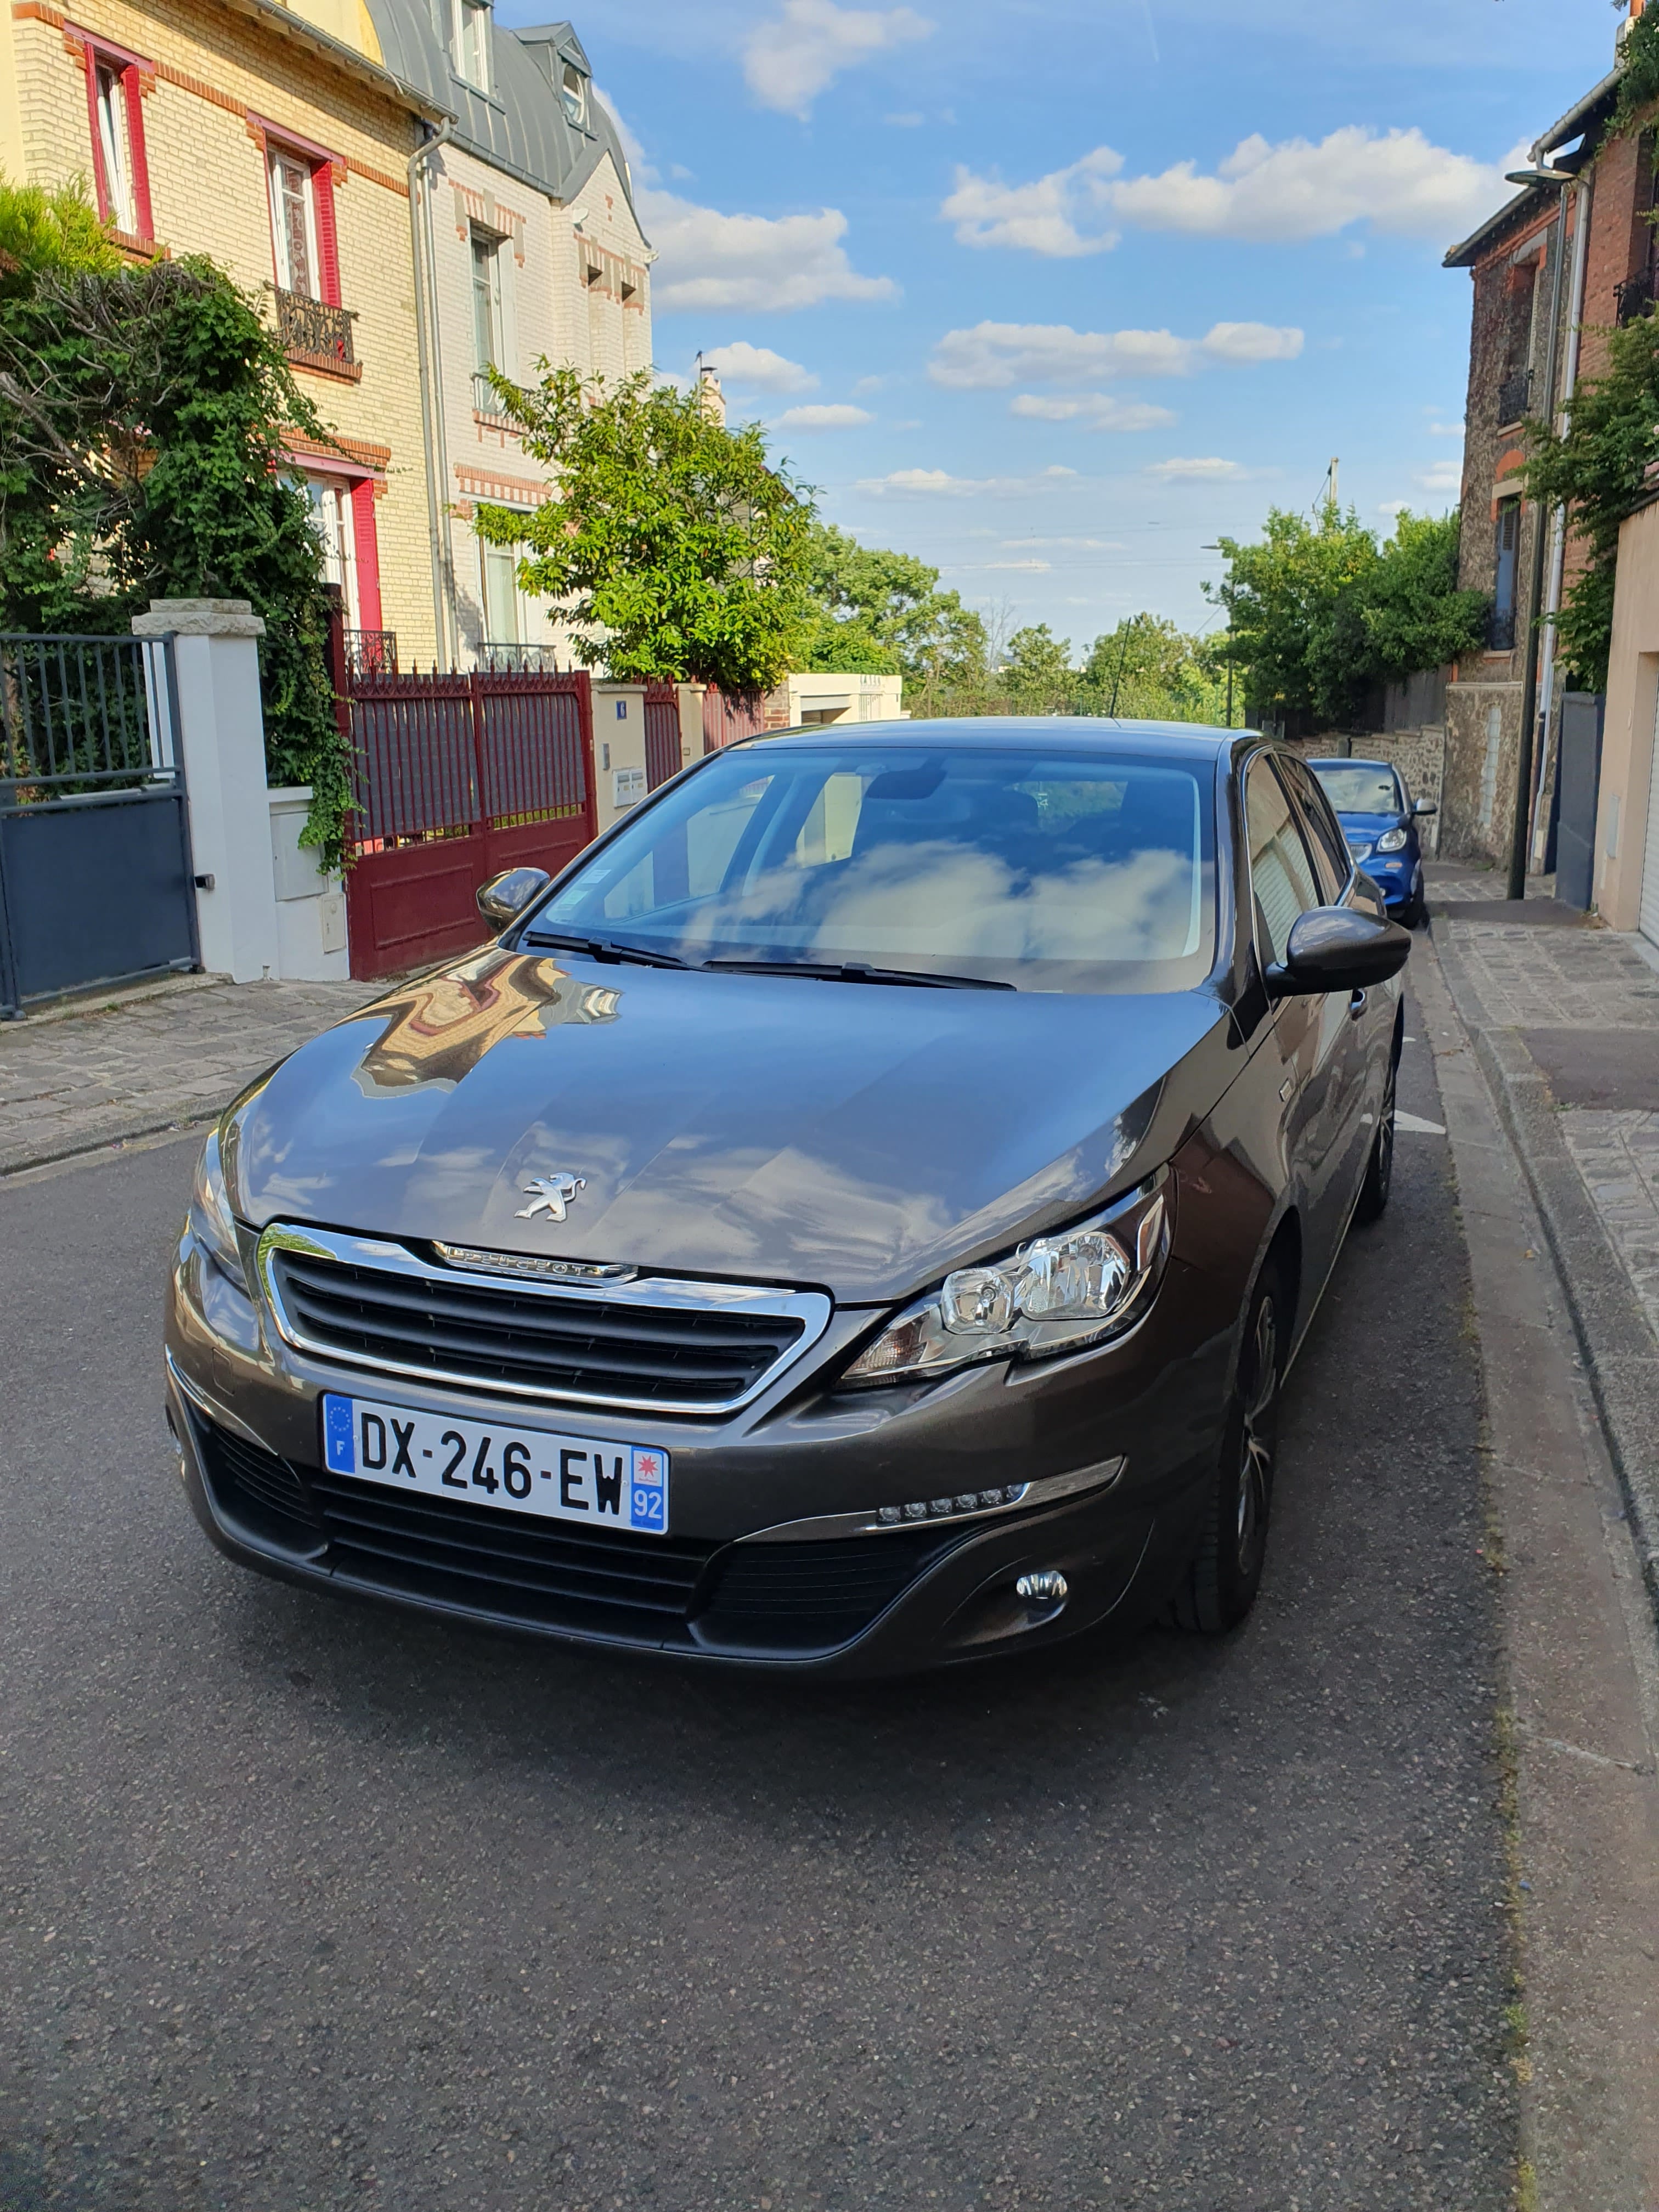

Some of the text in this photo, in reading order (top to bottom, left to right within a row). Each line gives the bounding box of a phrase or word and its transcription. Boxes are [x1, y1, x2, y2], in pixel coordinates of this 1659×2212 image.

[620, 702, 625, 717] 6
[464, 1252, 585, 1276] PEUGEOT
[336, 1440, 345, 1455] F
[361, 1412, 623, 1515] DX-246-EW
[634, 1489, 662, 1519] 92
